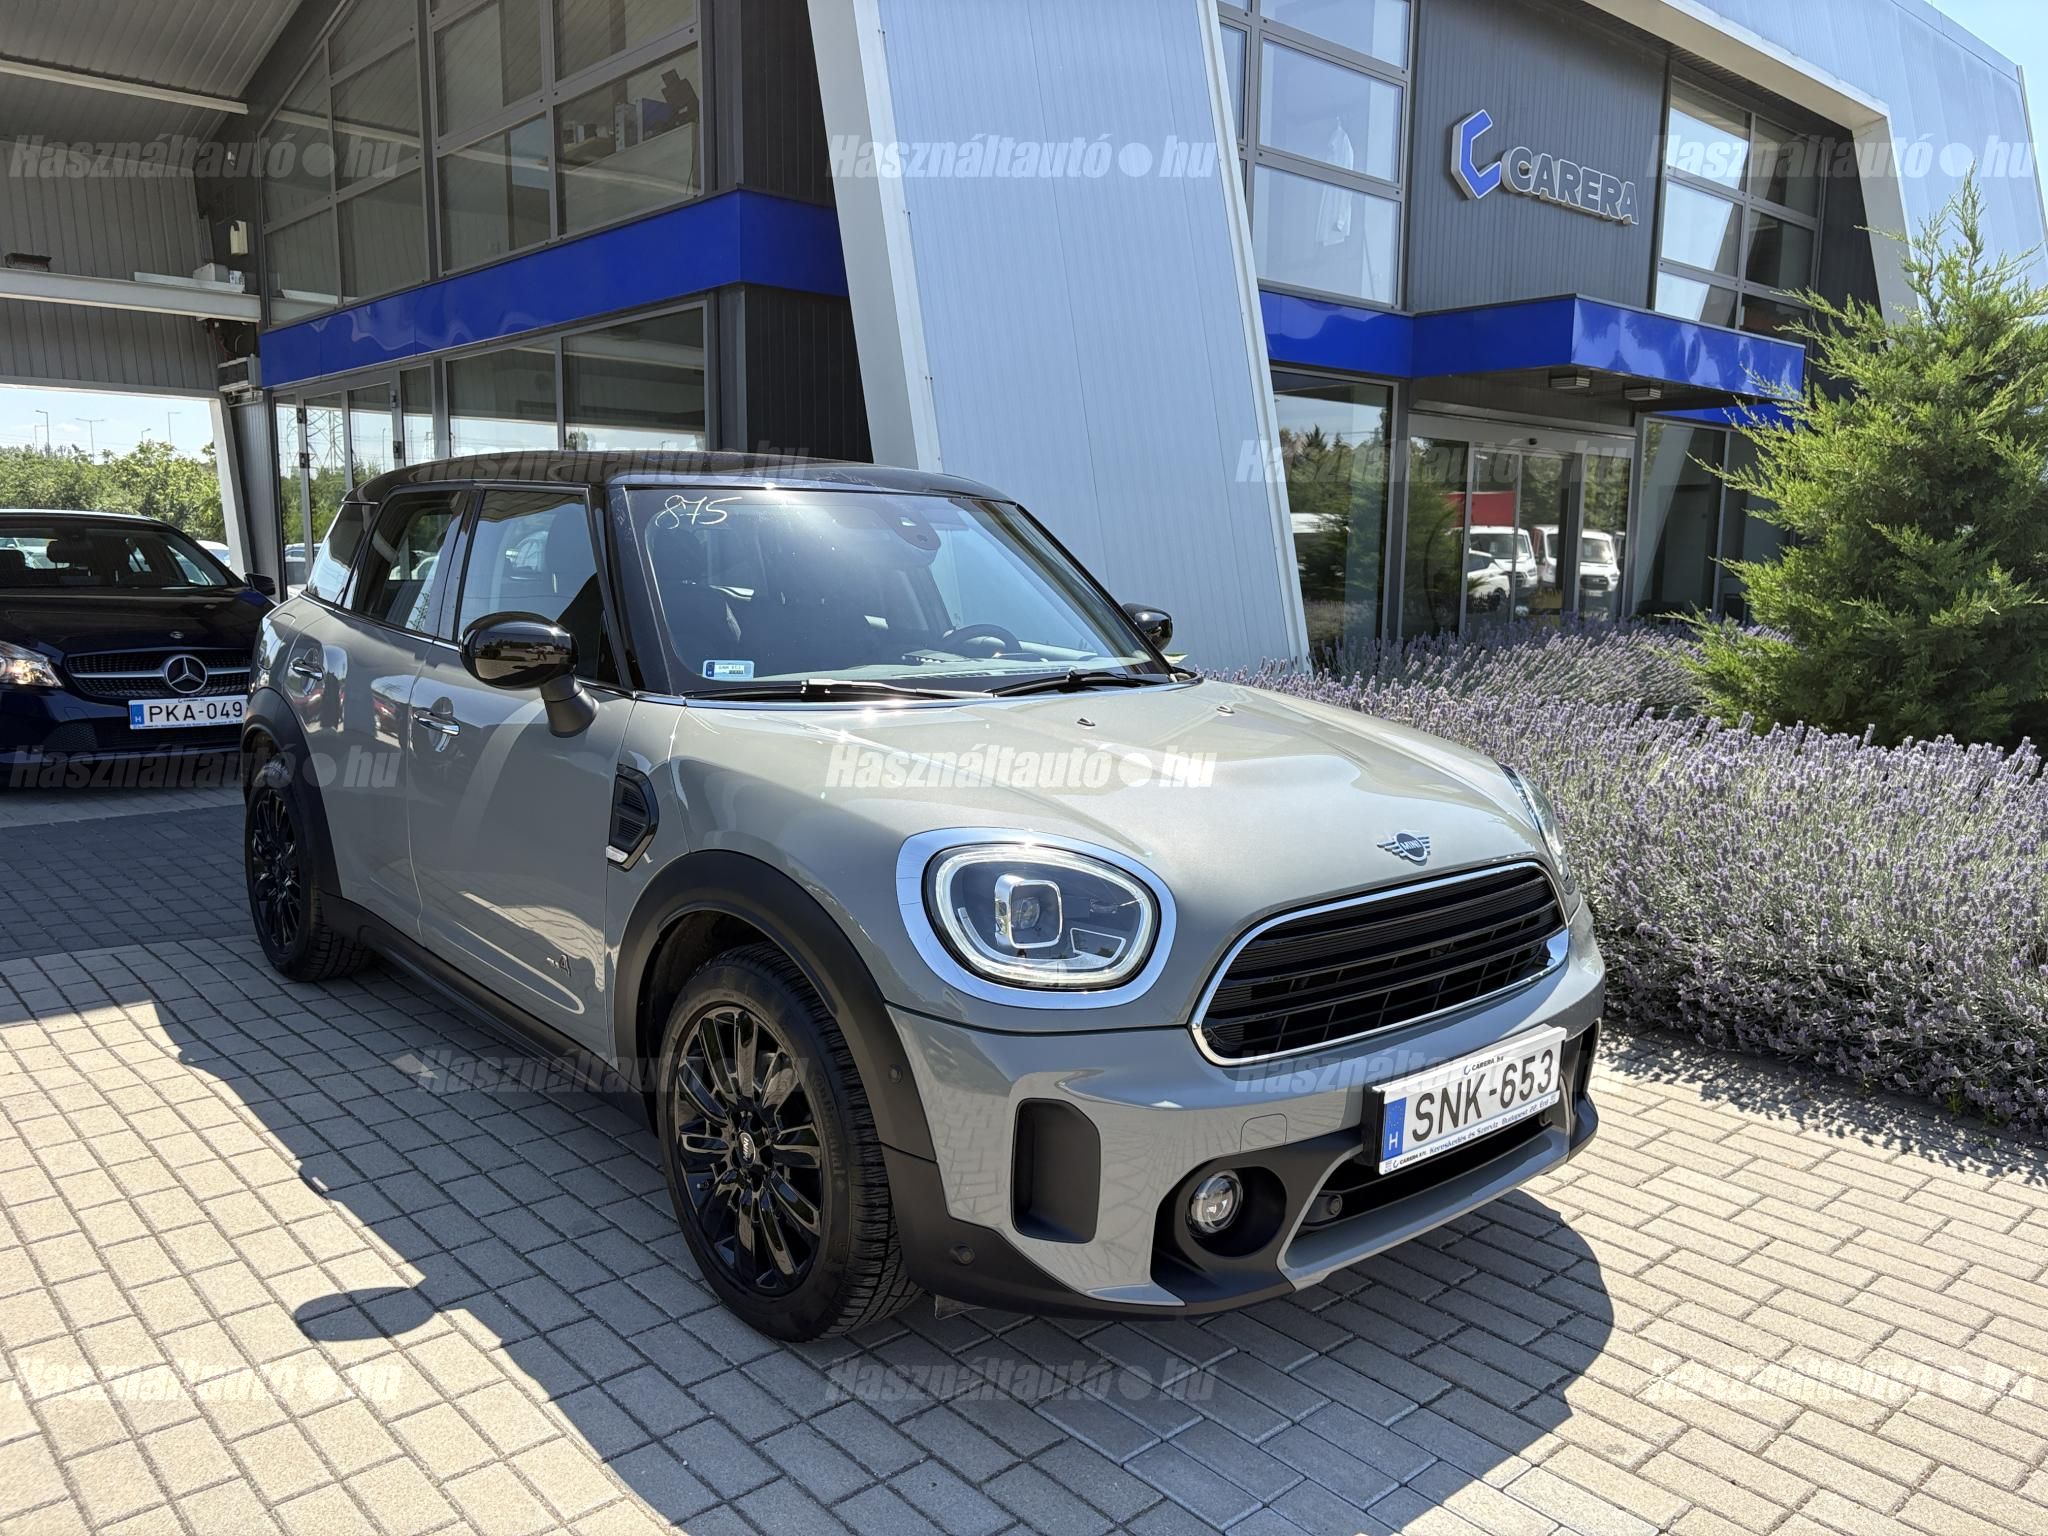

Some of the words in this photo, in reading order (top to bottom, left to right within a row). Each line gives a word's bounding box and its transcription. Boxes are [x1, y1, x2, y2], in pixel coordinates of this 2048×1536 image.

[1502, 146, 1639, 225] CARERA
[655, 494, 743, 530] 875
[148, 701, 243, 723] PKA-049
[1399, 839, 1422, 851] MINI
[1388, 1131, 1399, 1151] H
[1411, 1049, 1553, 1143] SNK-653
[742, 1136, 750, 1161] MINI
